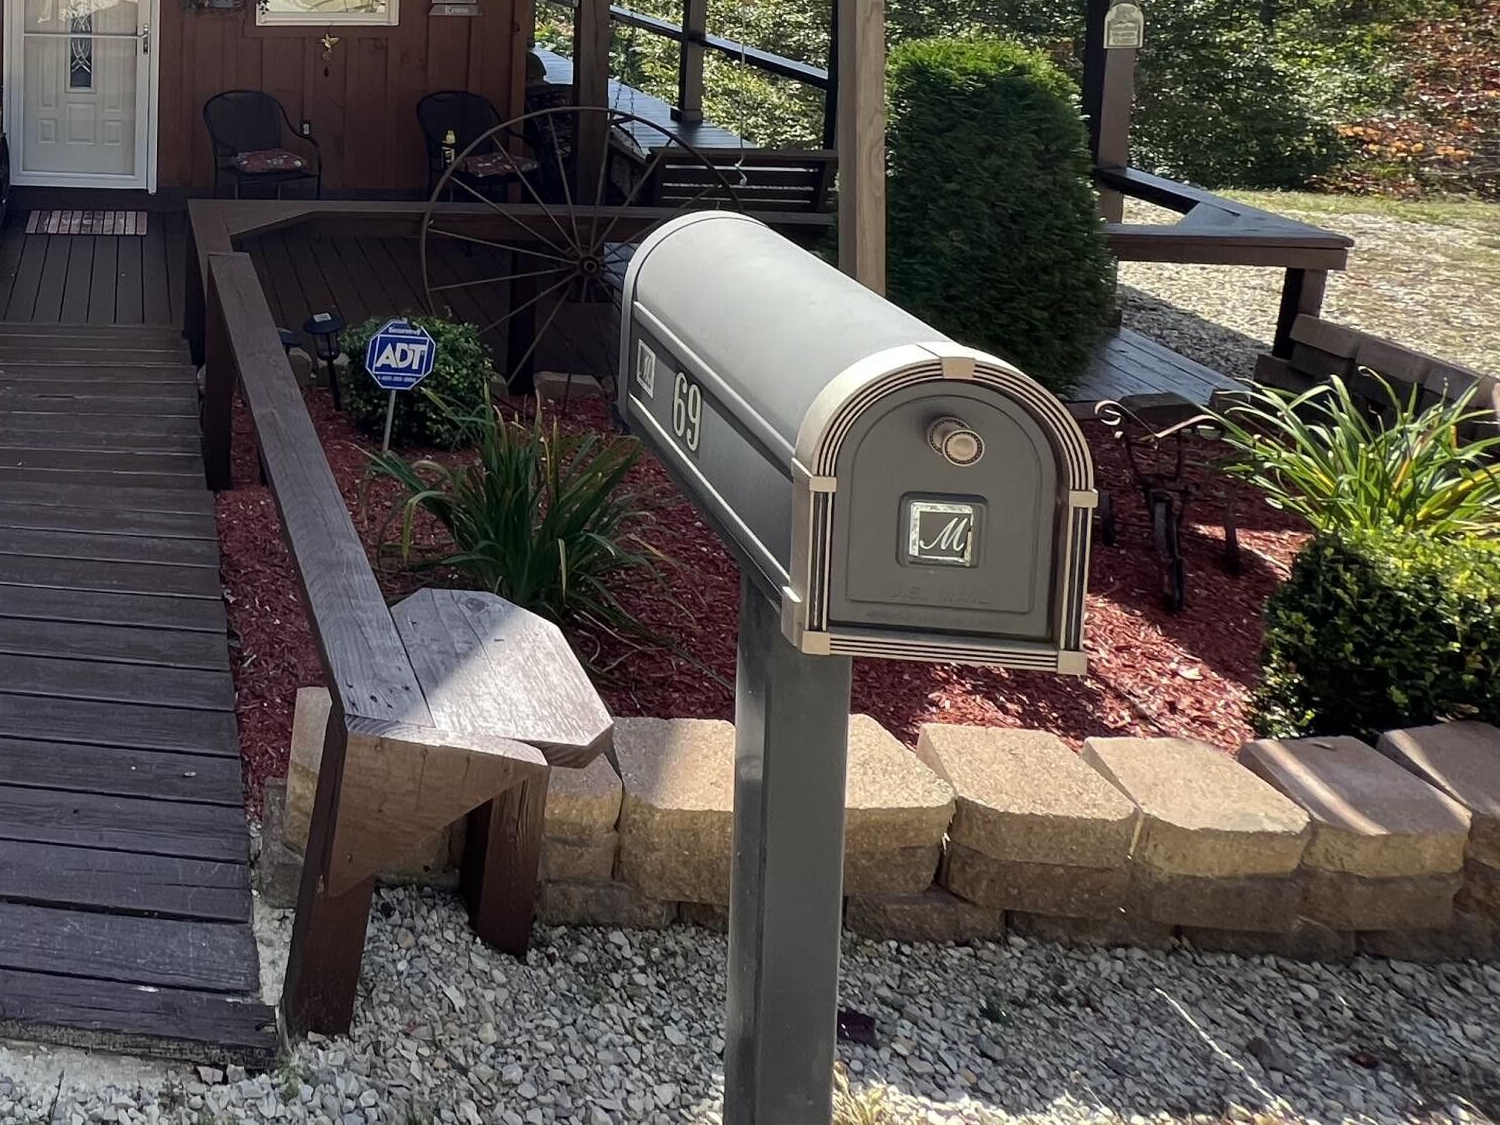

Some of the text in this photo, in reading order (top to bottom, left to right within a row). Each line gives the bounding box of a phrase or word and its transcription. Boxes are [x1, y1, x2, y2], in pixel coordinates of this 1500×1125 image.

[375, 342, 426, 370] ADT
[672, 371, 702, 452] 69
[919, 517, 969, 552] M
